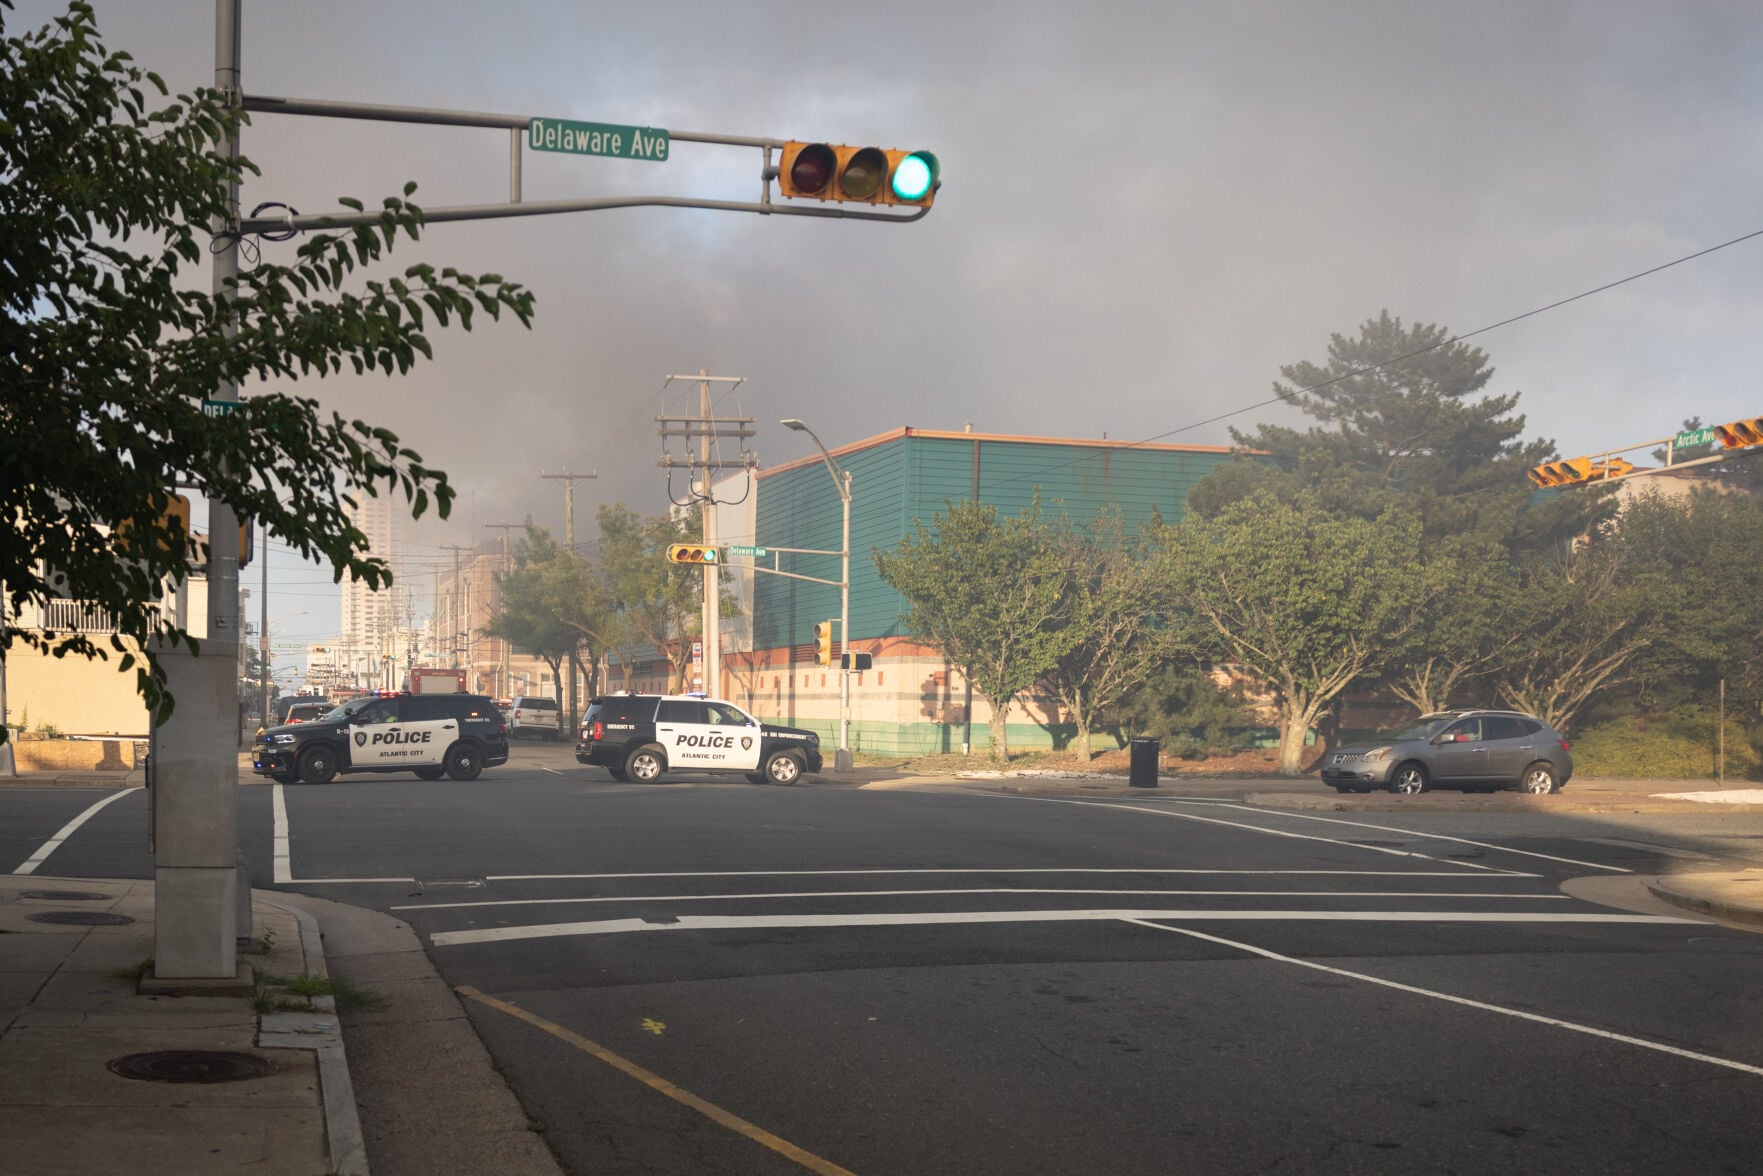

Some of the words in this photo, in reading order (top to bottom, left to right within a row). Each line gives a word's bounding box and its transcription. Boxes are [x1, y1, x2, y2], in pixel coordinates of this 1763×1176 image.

[532, 120, 622, 154] Delaware
[630, 129, 666, 158] Ave
[1677, 432, 1699, 447] Arctic
[755, 548, 766, 557] Ave
[372, 731, 432, 745] POLICE
[676, 734, 734, 748] POLICE
